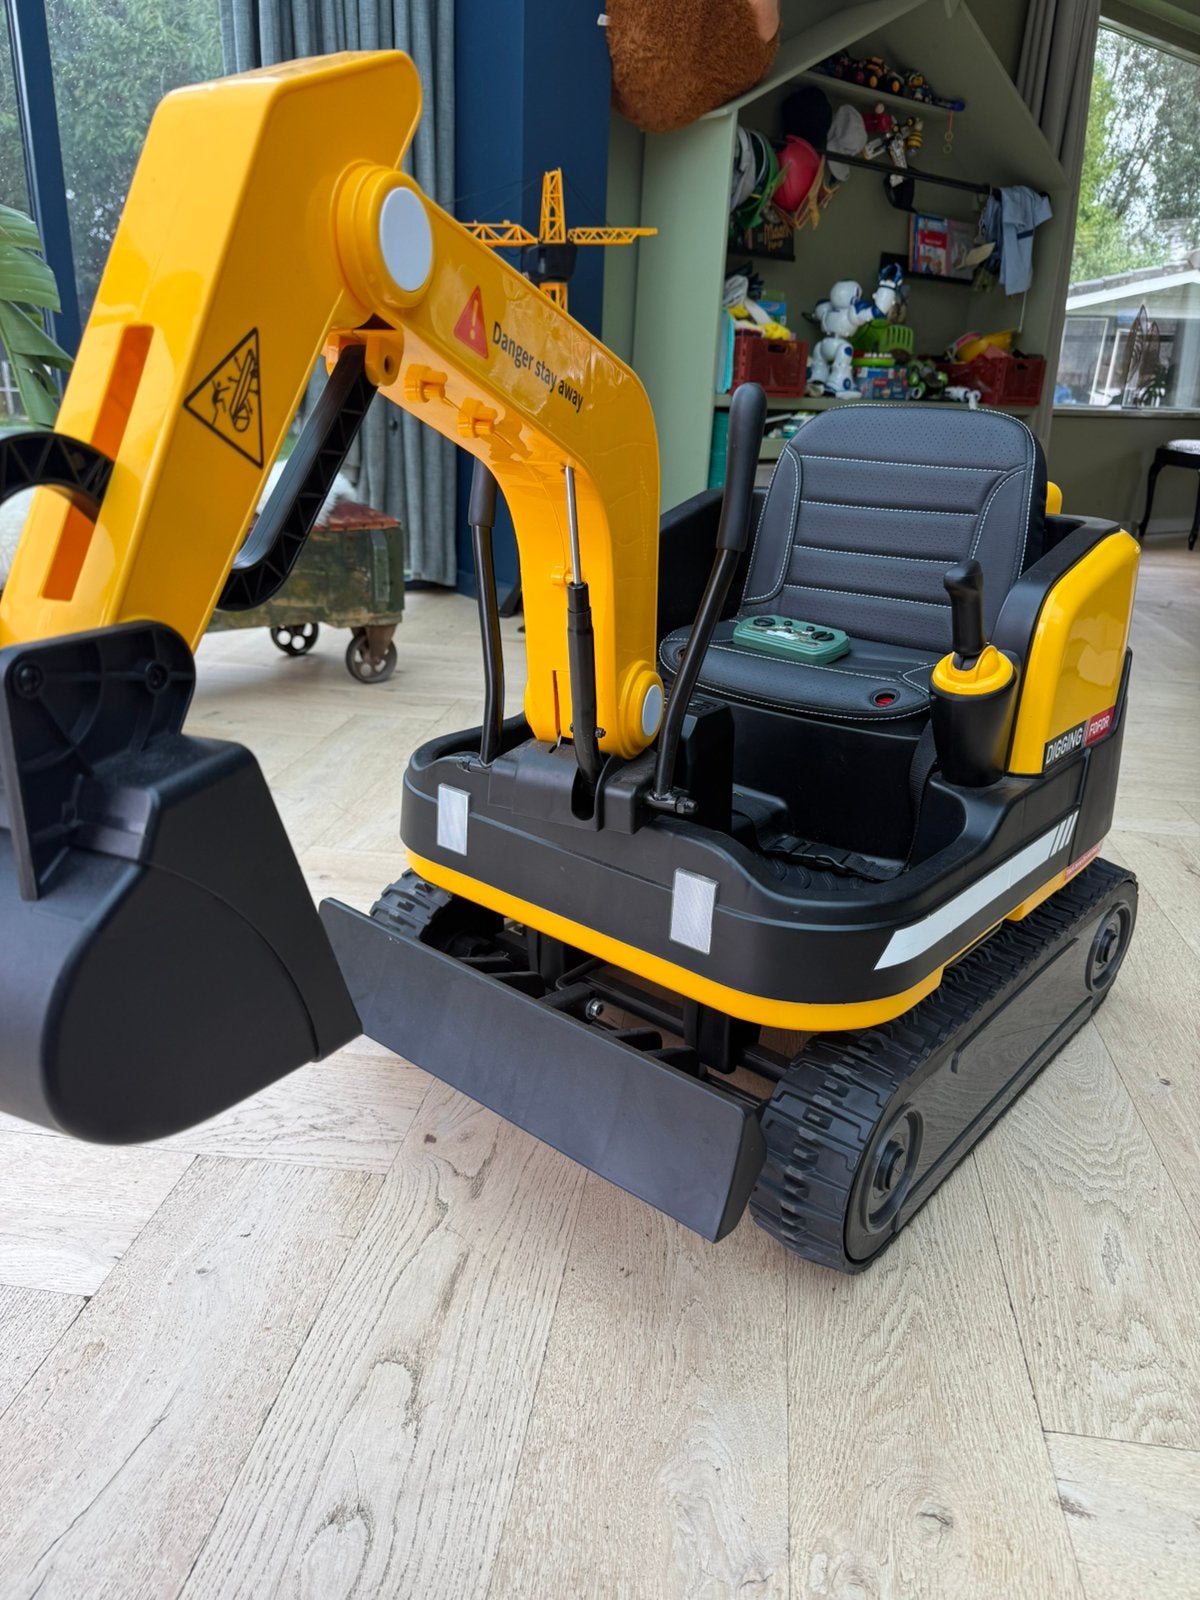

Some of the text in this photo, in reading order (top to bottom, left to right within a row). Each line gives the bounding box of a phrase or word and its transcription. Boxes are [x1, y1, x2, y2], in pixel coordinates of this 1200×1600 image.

[492, 321, 584, 413] Danger stay away
[1046, 727, 1083, 764] DIGGING
